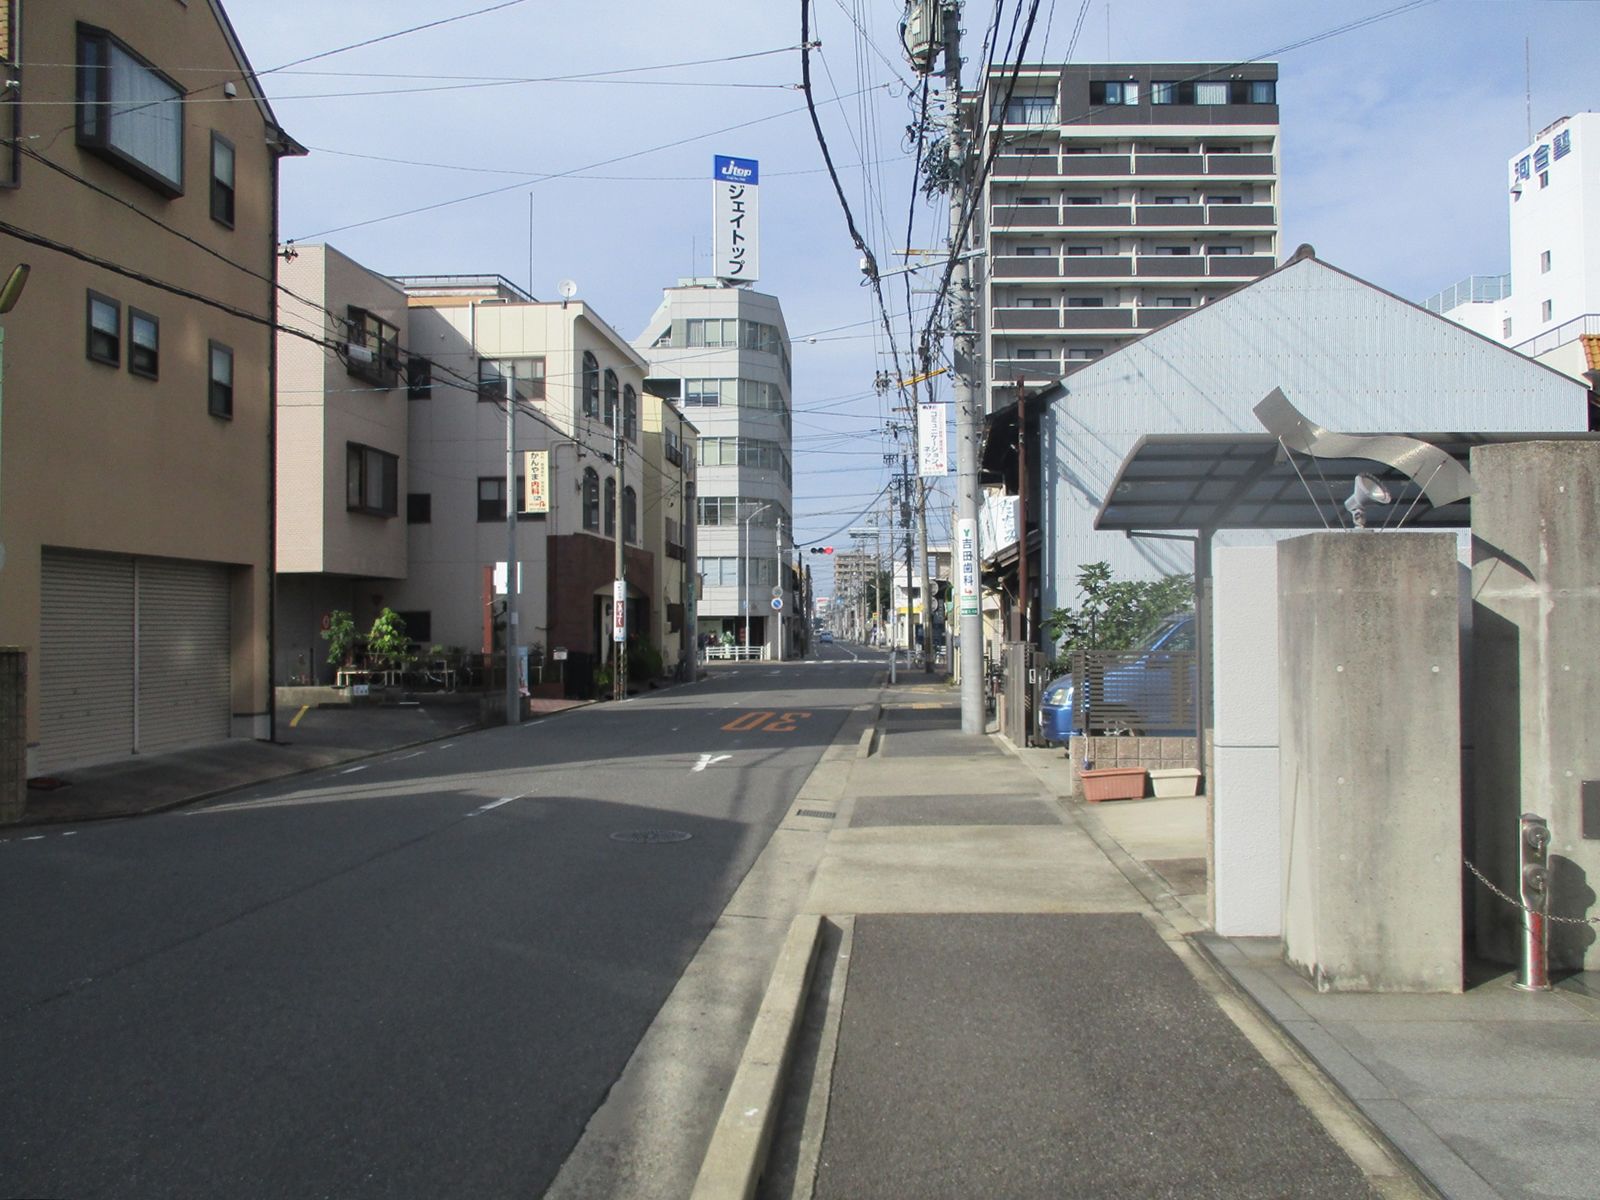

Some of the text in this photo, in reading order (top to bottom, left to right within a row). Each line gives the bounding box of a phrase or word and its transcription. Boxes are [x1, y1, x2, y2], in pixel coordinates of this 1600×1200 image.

[729, 185, 746, 275] ジェイトップ
[962, 539, 973, 586] 吉田歯科
[721, 712, 812, 732] 30
